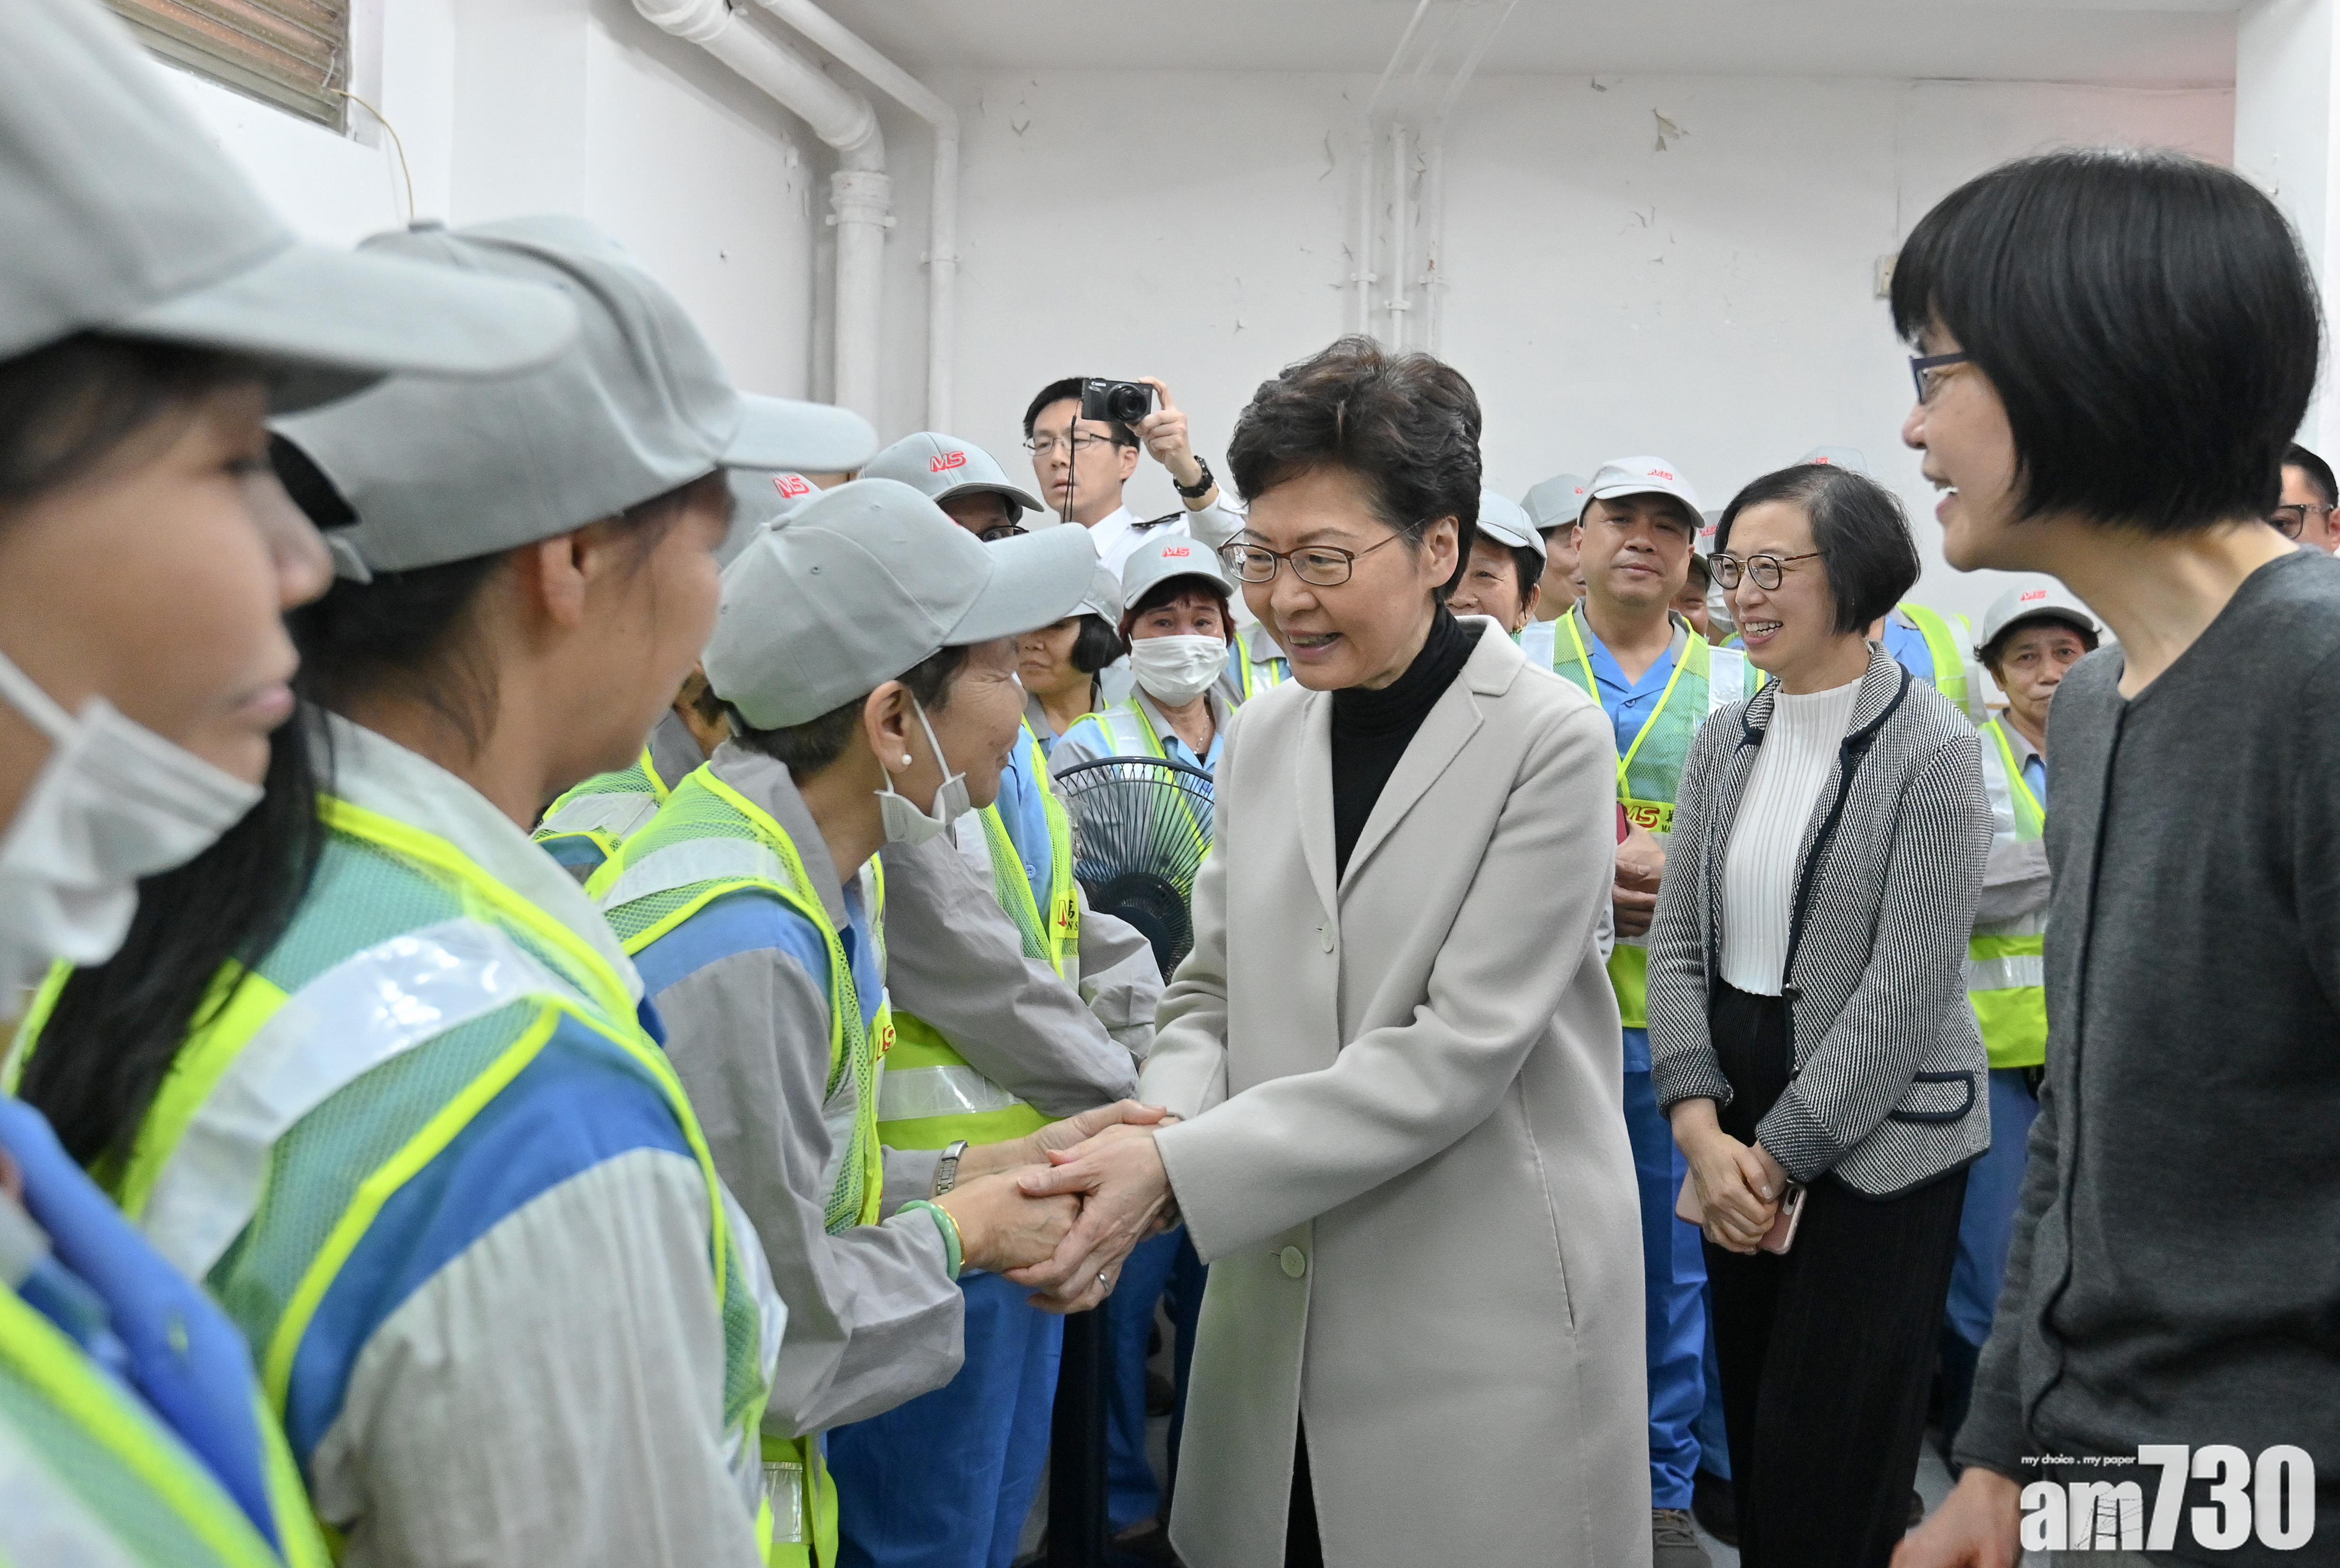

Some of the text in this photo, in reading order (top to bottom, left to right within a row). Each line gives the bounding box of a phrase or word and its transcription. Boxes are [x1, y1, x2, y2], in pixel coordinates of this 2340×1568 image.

[930, 451, 966, 472] MS
[773, 475, 810, 499] MS
[1162, 547, 1190, 557] MS
